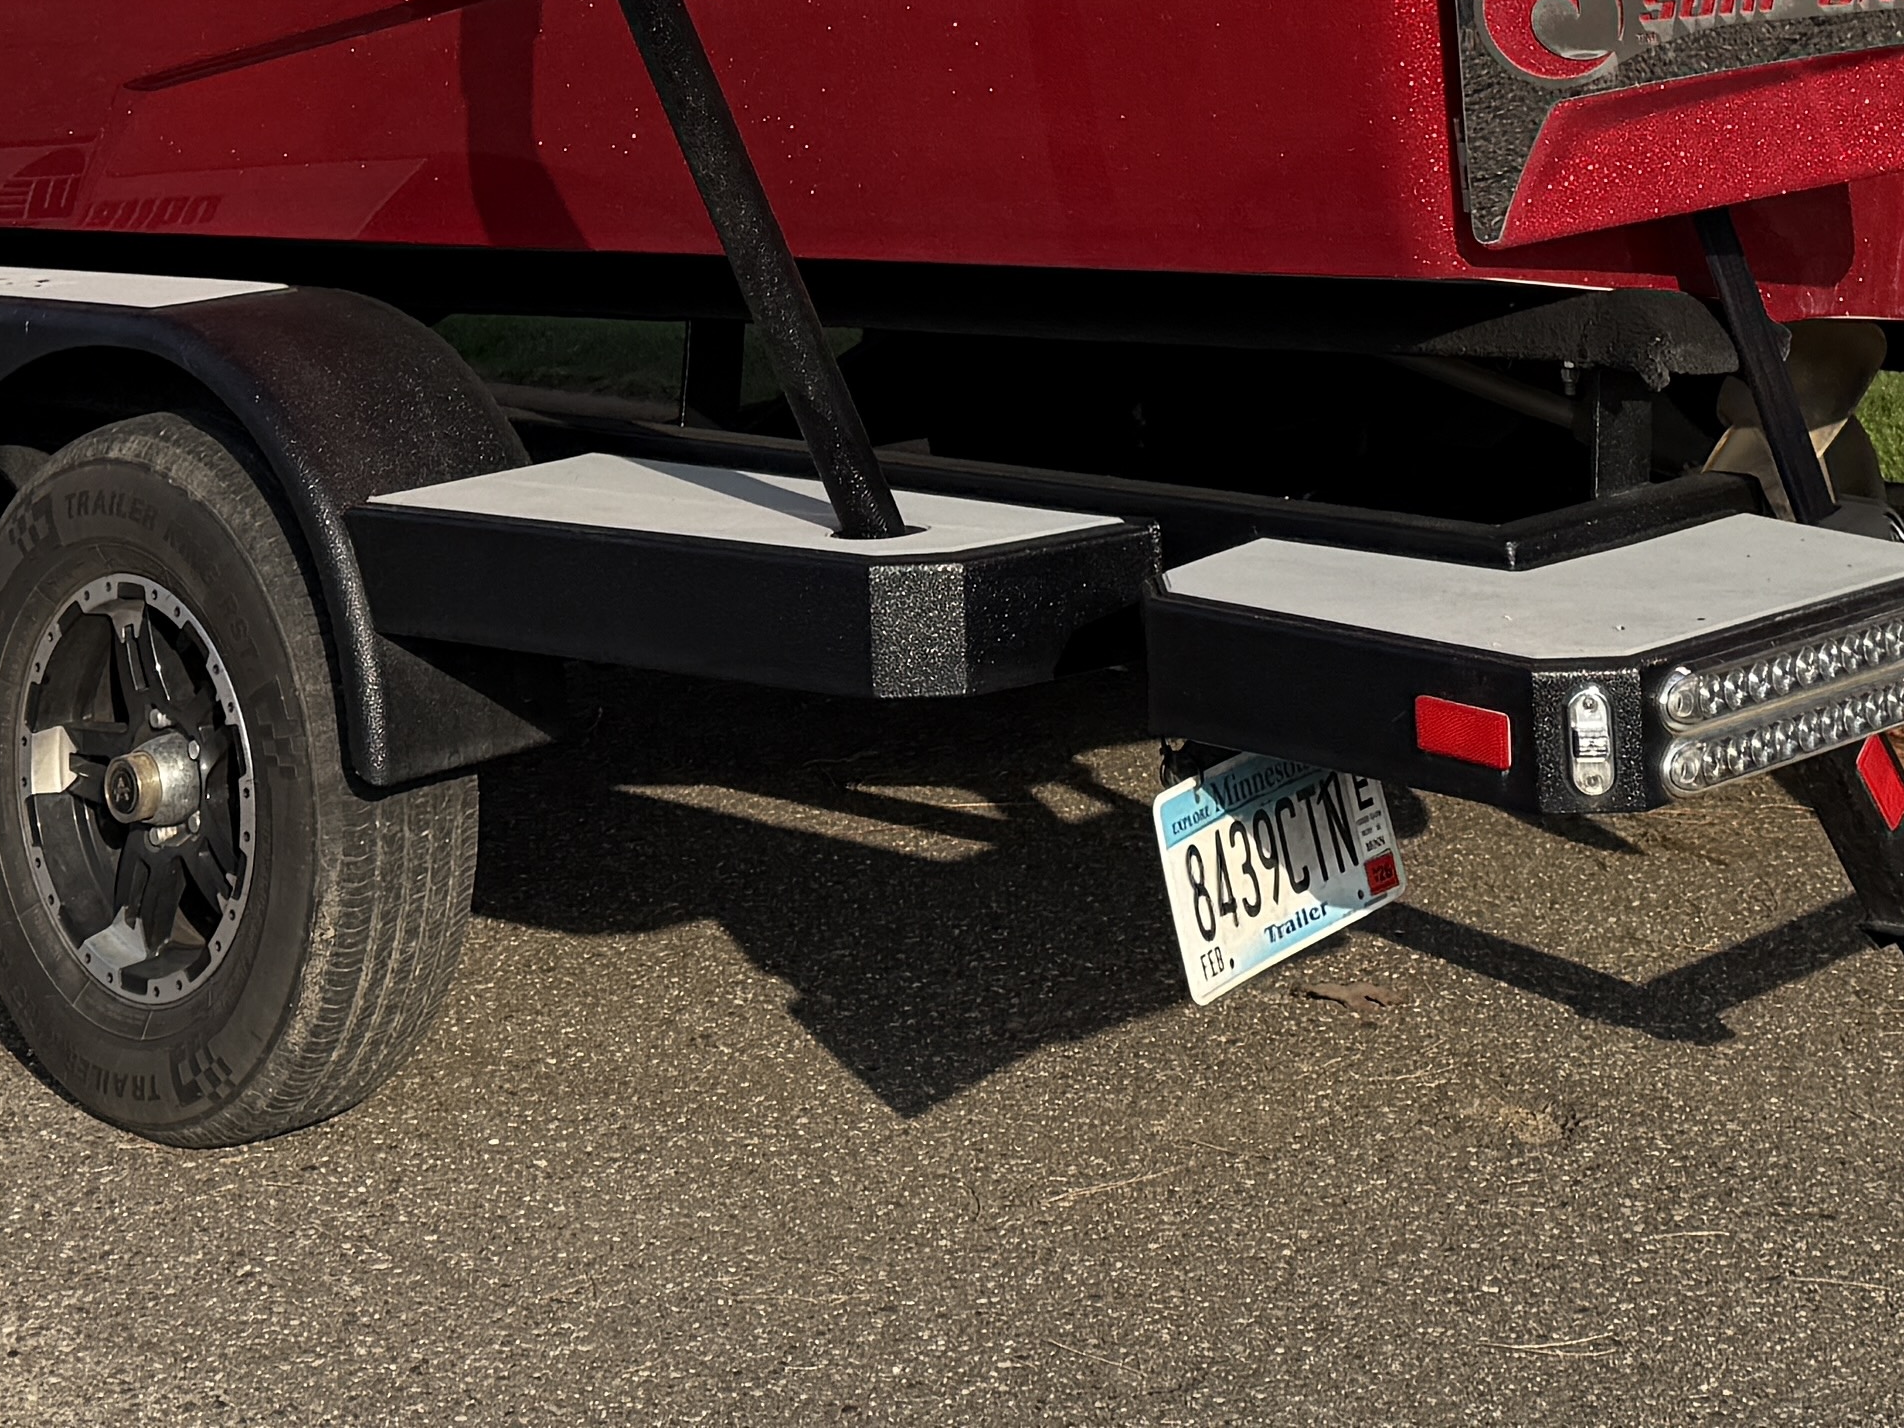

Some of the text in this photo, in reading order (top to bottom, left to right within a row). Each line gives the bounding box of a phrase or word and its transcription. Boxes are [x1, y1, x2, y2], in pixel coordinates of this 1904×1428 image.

[64, 489, 160, 530] TRAILER
[1186, 771, 1360, 942] 8439CTN
[1264, 901, 1329, 944] Trailer
[1200, 946, 1226, 982] FEB
